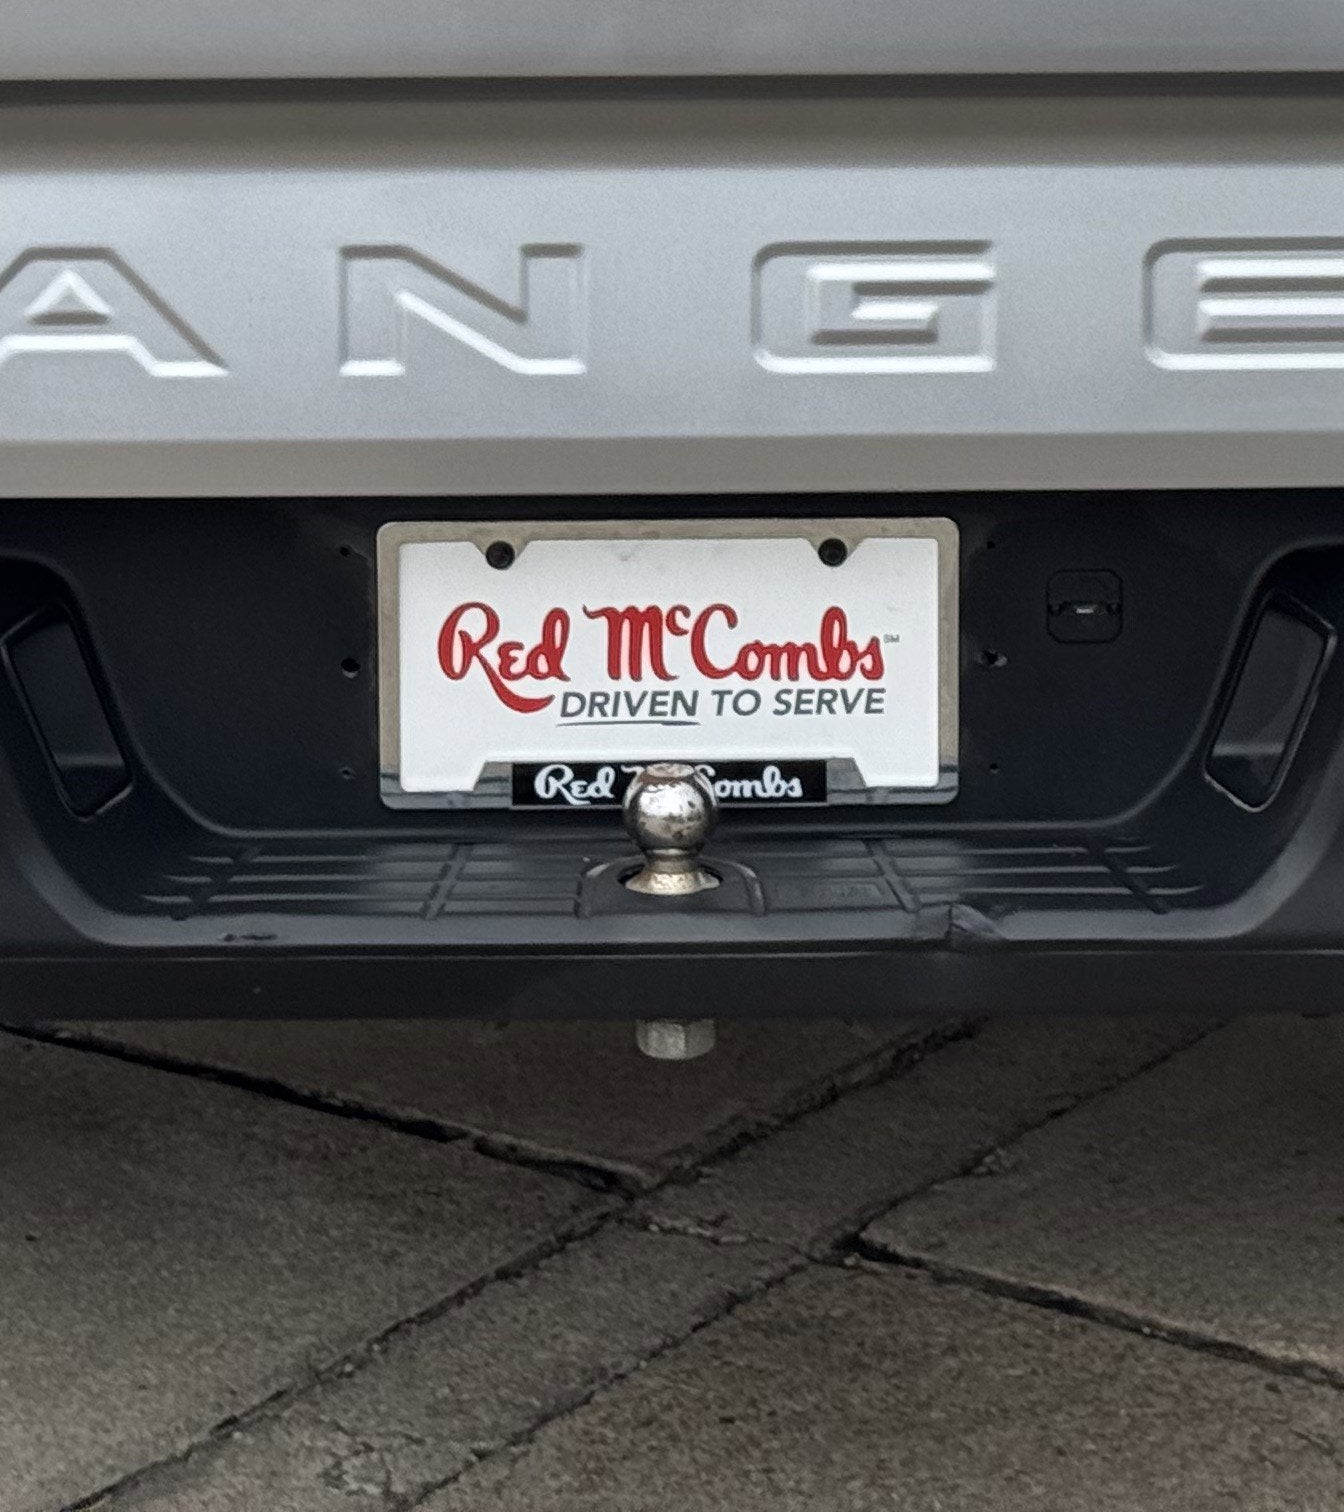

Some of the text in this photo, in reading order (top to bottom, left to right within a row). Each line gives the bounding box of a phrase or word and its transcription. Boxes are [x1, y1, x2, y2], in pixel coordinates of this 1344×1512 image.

[438, 601, 571, 713] Red
[582, 603, 885, 682] McCombs
[559, 687, 886, 718] DRIVEN TO SERVE
[534, 764, 616, 805] Red
